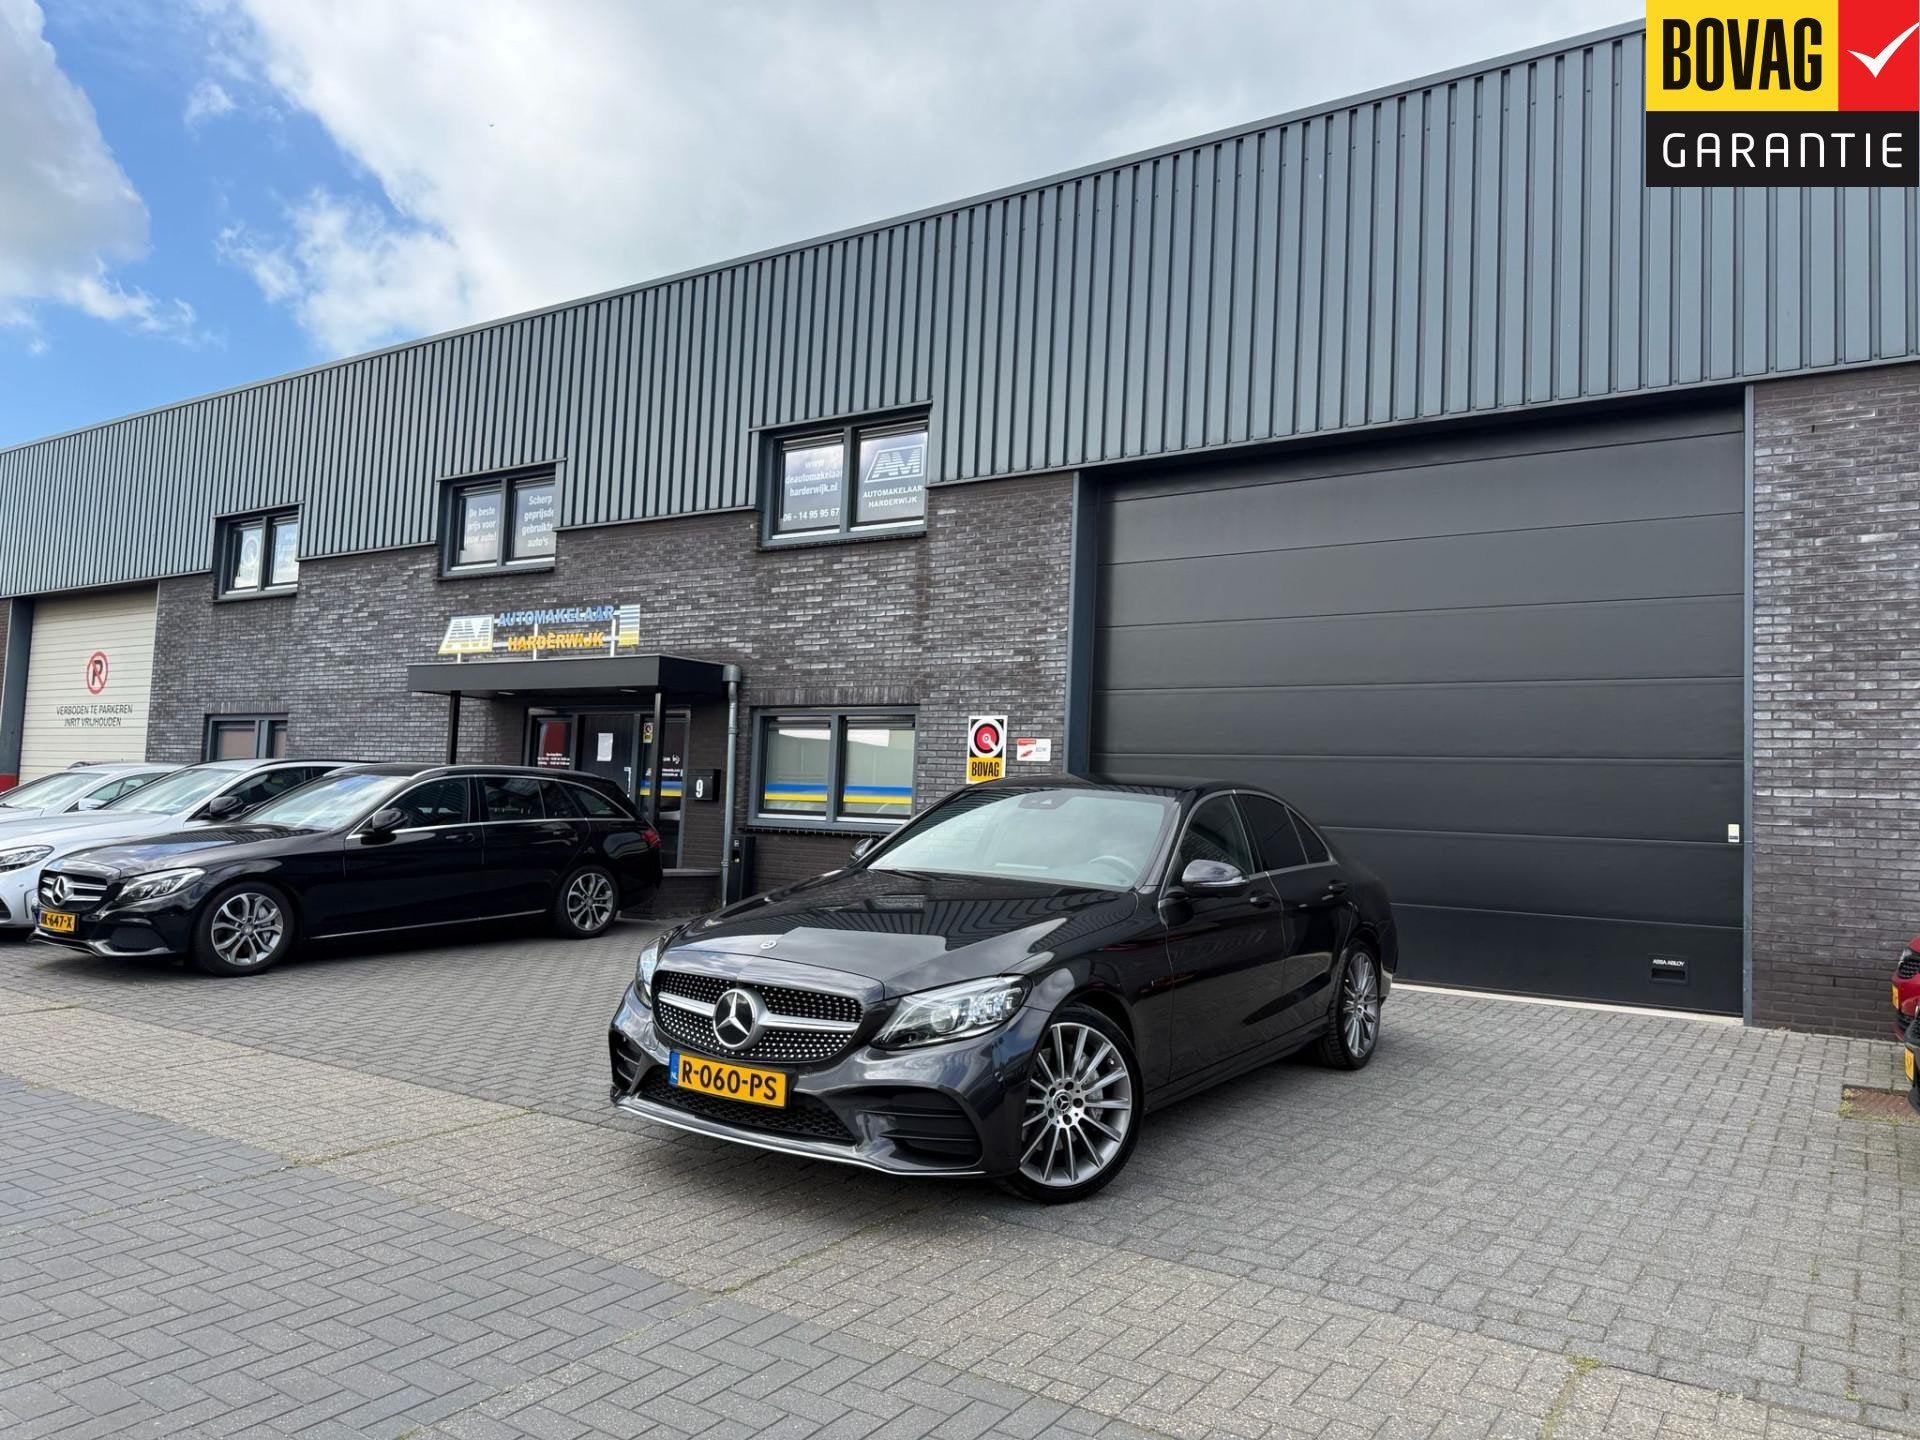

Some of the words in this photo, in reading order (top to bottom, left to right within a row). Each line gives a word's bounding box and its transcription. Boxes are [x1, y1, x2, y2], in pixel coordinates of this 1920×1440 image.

[789, 481, 838, 497] harderwijk.nl
[862, 485, 923, 498] AUTOMAKELAAR
[529, 495, 553, 506] Scherp
[869, 496, 918, 508] HARDERWIJK
[497, 605, 615, 627] AUTOMAKELAAR
[507, 630, 605, 651] HARDERWIJK
[56, 705, 89, 716] VERBODEN
[90, 705, 98, 715] TE
[98, 704, 133, 715] PARKEREN
[81, 717, 122, 727] VRIJHOUDEN
[971, 761, 1000, 777] BOVAG
[695, 779, 704, 798] 9
[682, 1060, 777, 1100] R-060-PS
